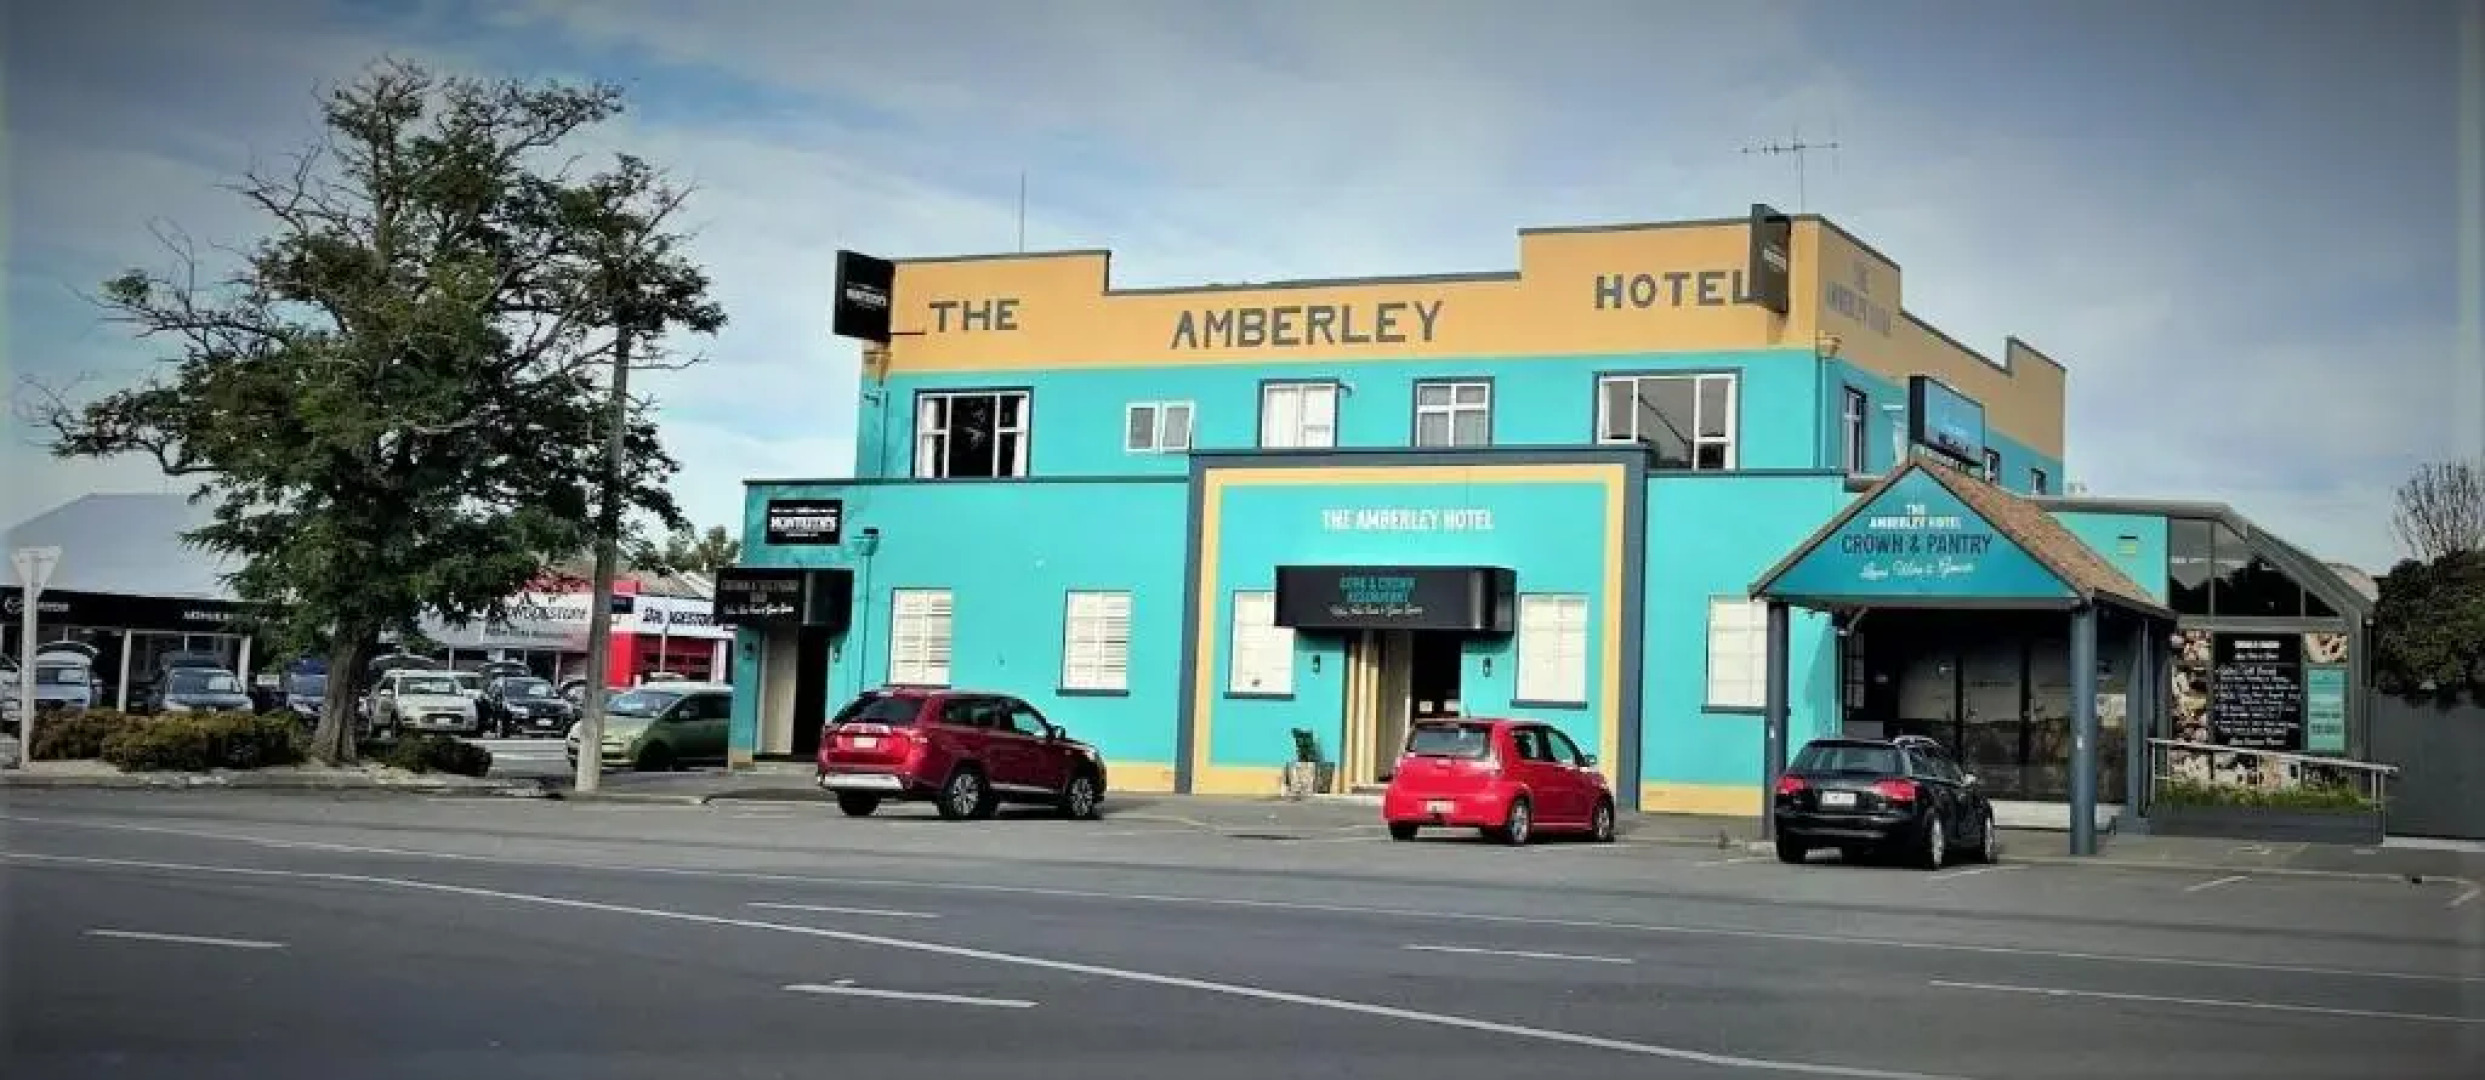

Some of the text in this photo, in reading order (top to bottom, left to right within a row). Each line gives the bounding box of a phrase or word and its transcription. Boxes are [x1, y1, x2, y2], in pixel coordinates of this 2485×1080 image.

[929, 268, 1754, 350] THE AMBERLEY HOTEL
[1322, 508, 1495, 530] THE AMBERLEY HOTEL
[1841, 533, 1903, 555] CROWN
[1926, 533, 1993, 555] PANTRY
